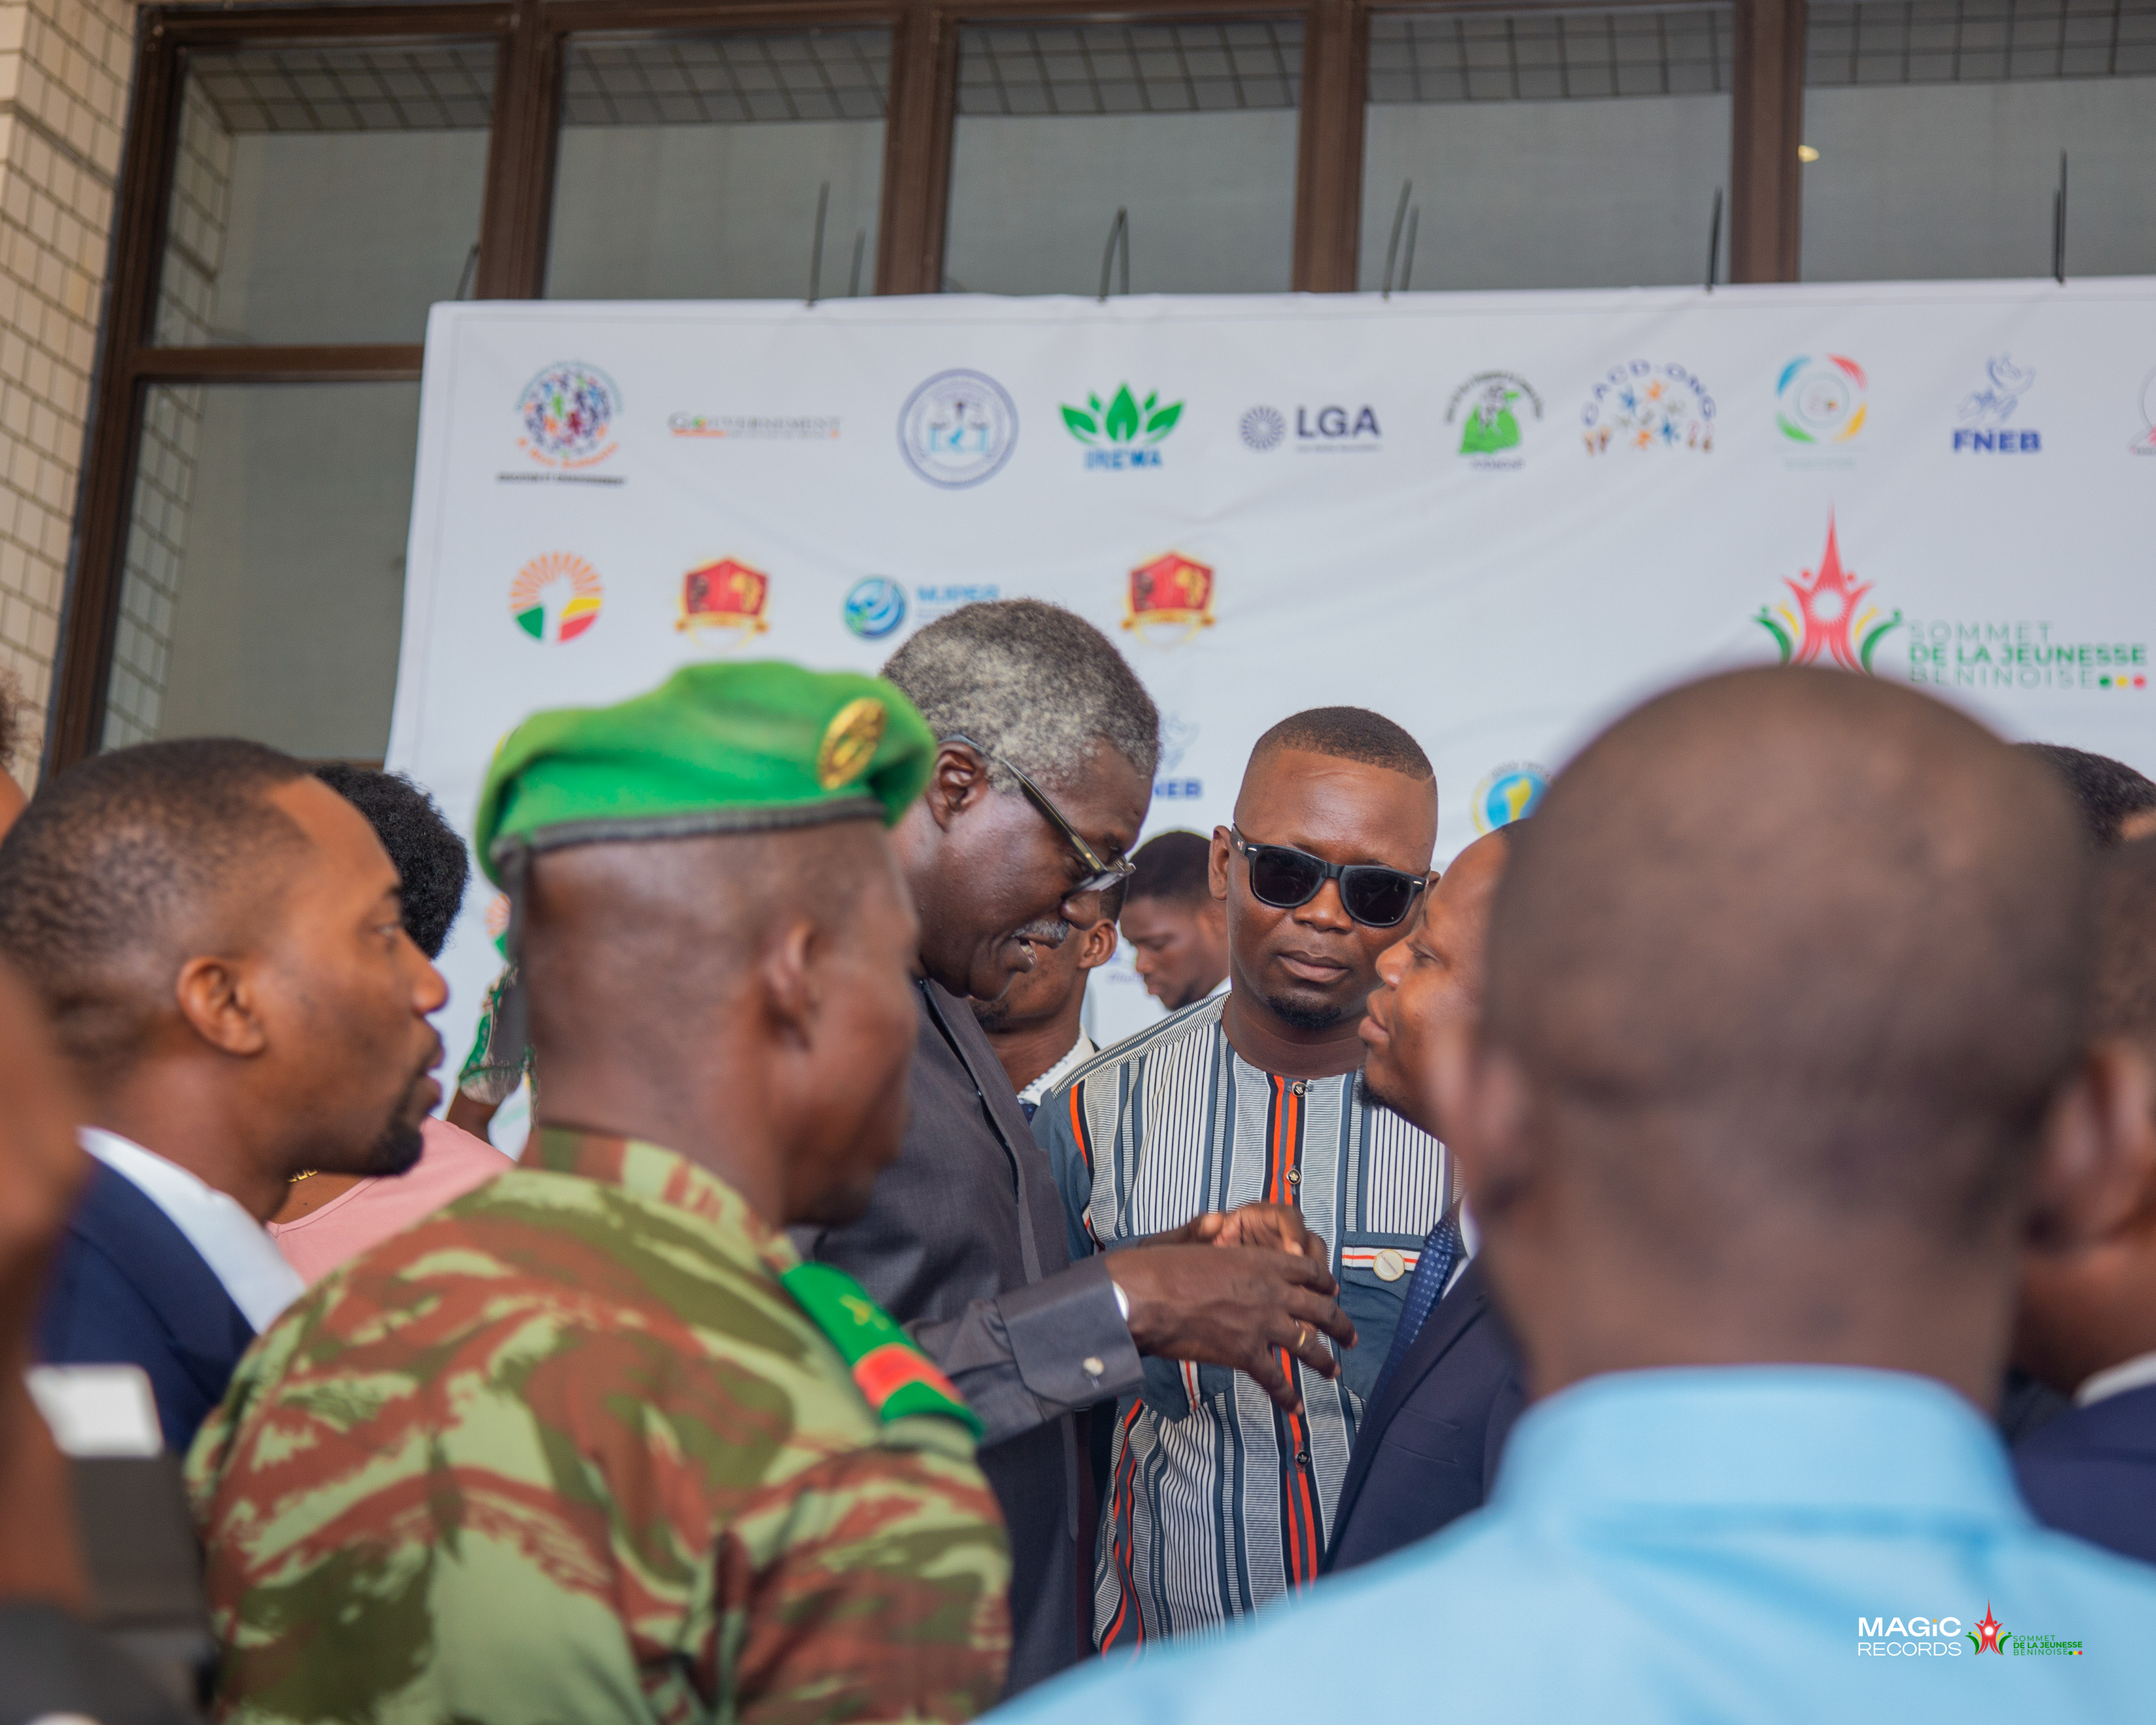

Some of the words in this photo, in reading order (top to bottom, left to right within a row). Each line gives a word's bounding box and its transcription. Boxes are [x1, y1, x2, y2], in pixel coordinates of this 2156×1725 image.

[1296, 405, 1381, 438] LGA
[1953, 429, 2042, 454] FNEB
[1909, 620, 2052, 643] SOMMET
[1909, 644, 1947, 665] DE
[1956, 644, 1991, 665] LA
[2000, 643, 2147, 665] JEUNESSE
[1152, 779, 1204, 799] NEB
